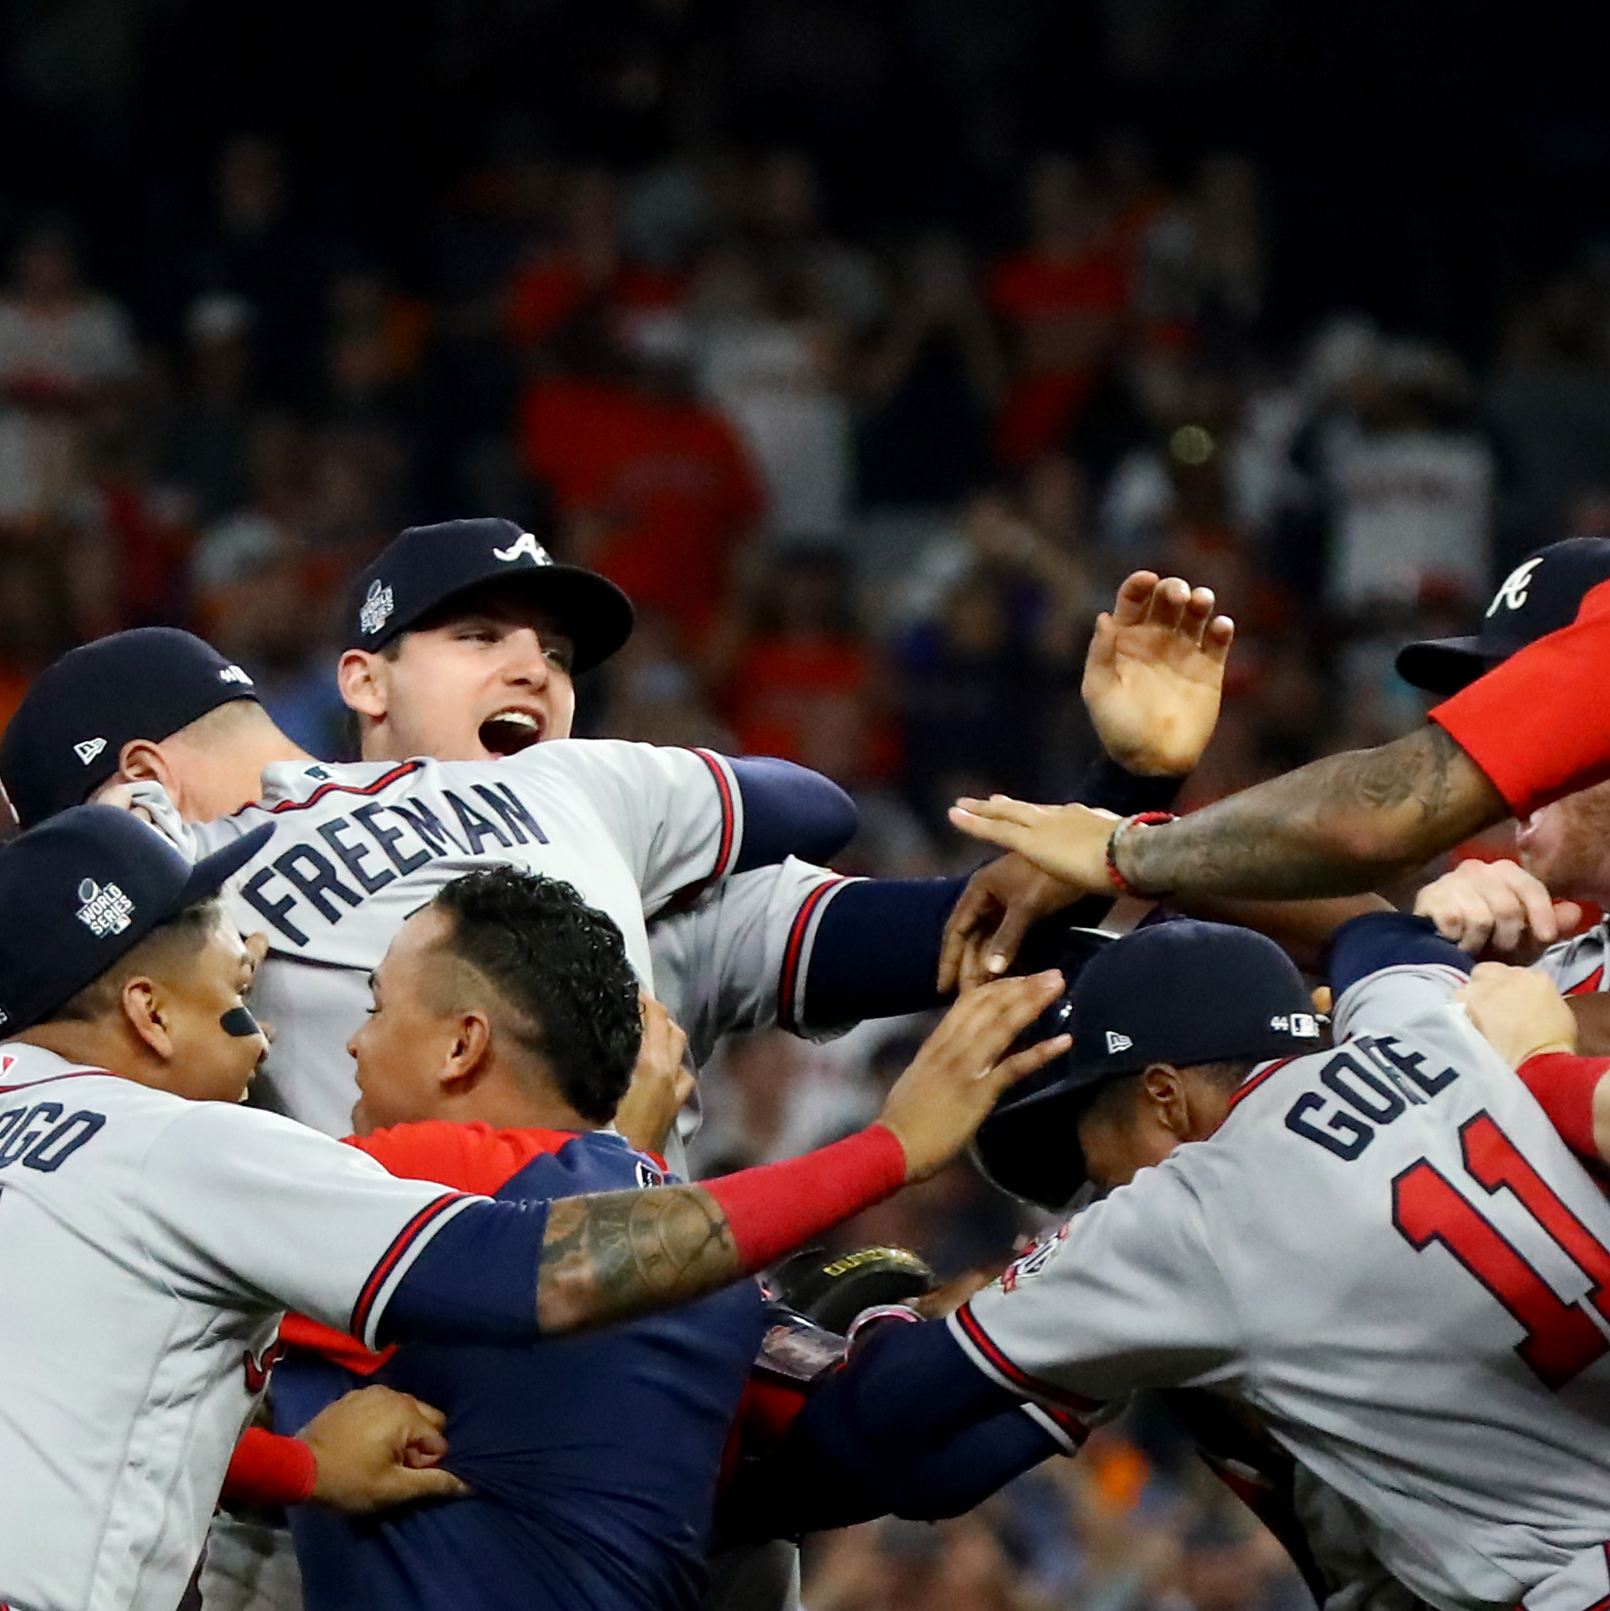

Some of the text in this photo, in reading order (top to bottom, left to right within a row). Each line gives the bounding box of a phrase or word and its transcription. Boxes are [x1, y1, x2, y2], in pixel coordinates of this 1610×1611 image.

[1485, 557, 1544, 618] A
[240, 782, 550, 947] FREEMAN
[78, 885, 123, 925] WORLD
[90, 895, 132, 935] SERIES
[1270, 1016, 1289, 1030] 44
